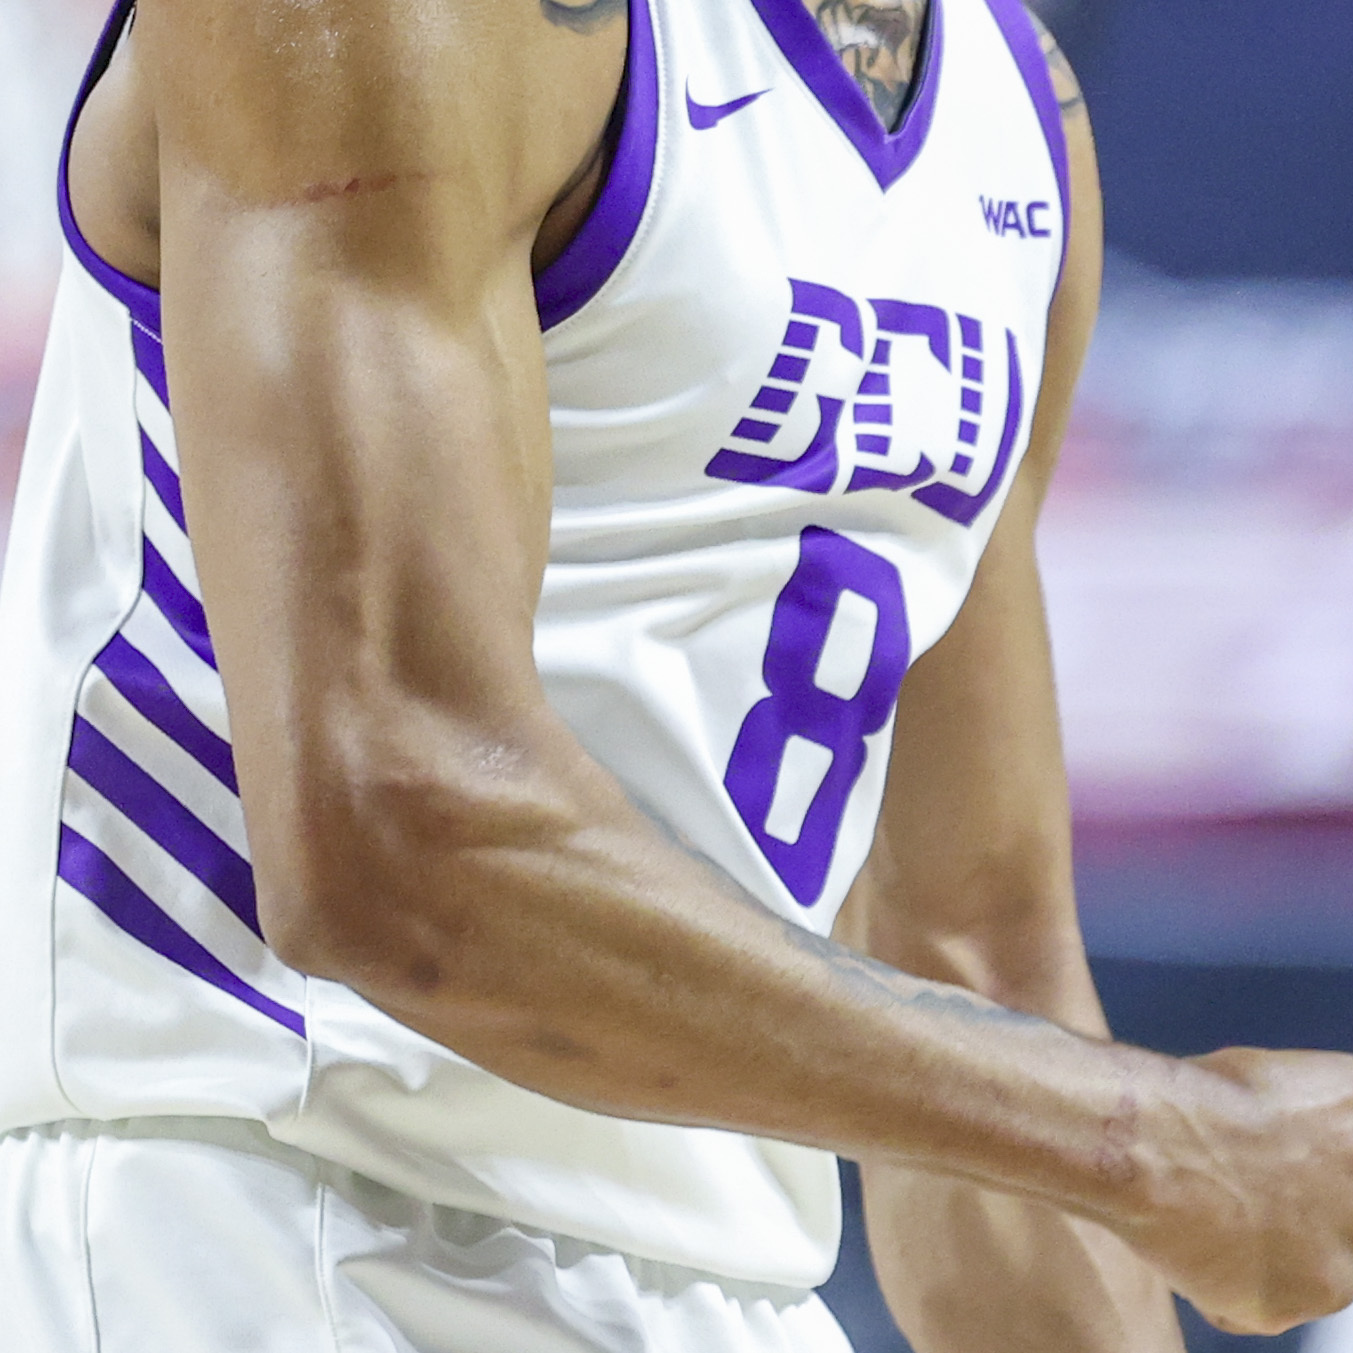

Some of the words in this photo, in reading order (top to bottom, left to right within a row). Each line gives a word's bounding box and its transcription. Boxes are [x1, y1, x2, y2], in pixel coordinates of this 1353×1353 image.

[979, 195, 1051, 238] WAC
[704, 277, 1023, 528] GCU
[723, 524, 911, 908] 8
